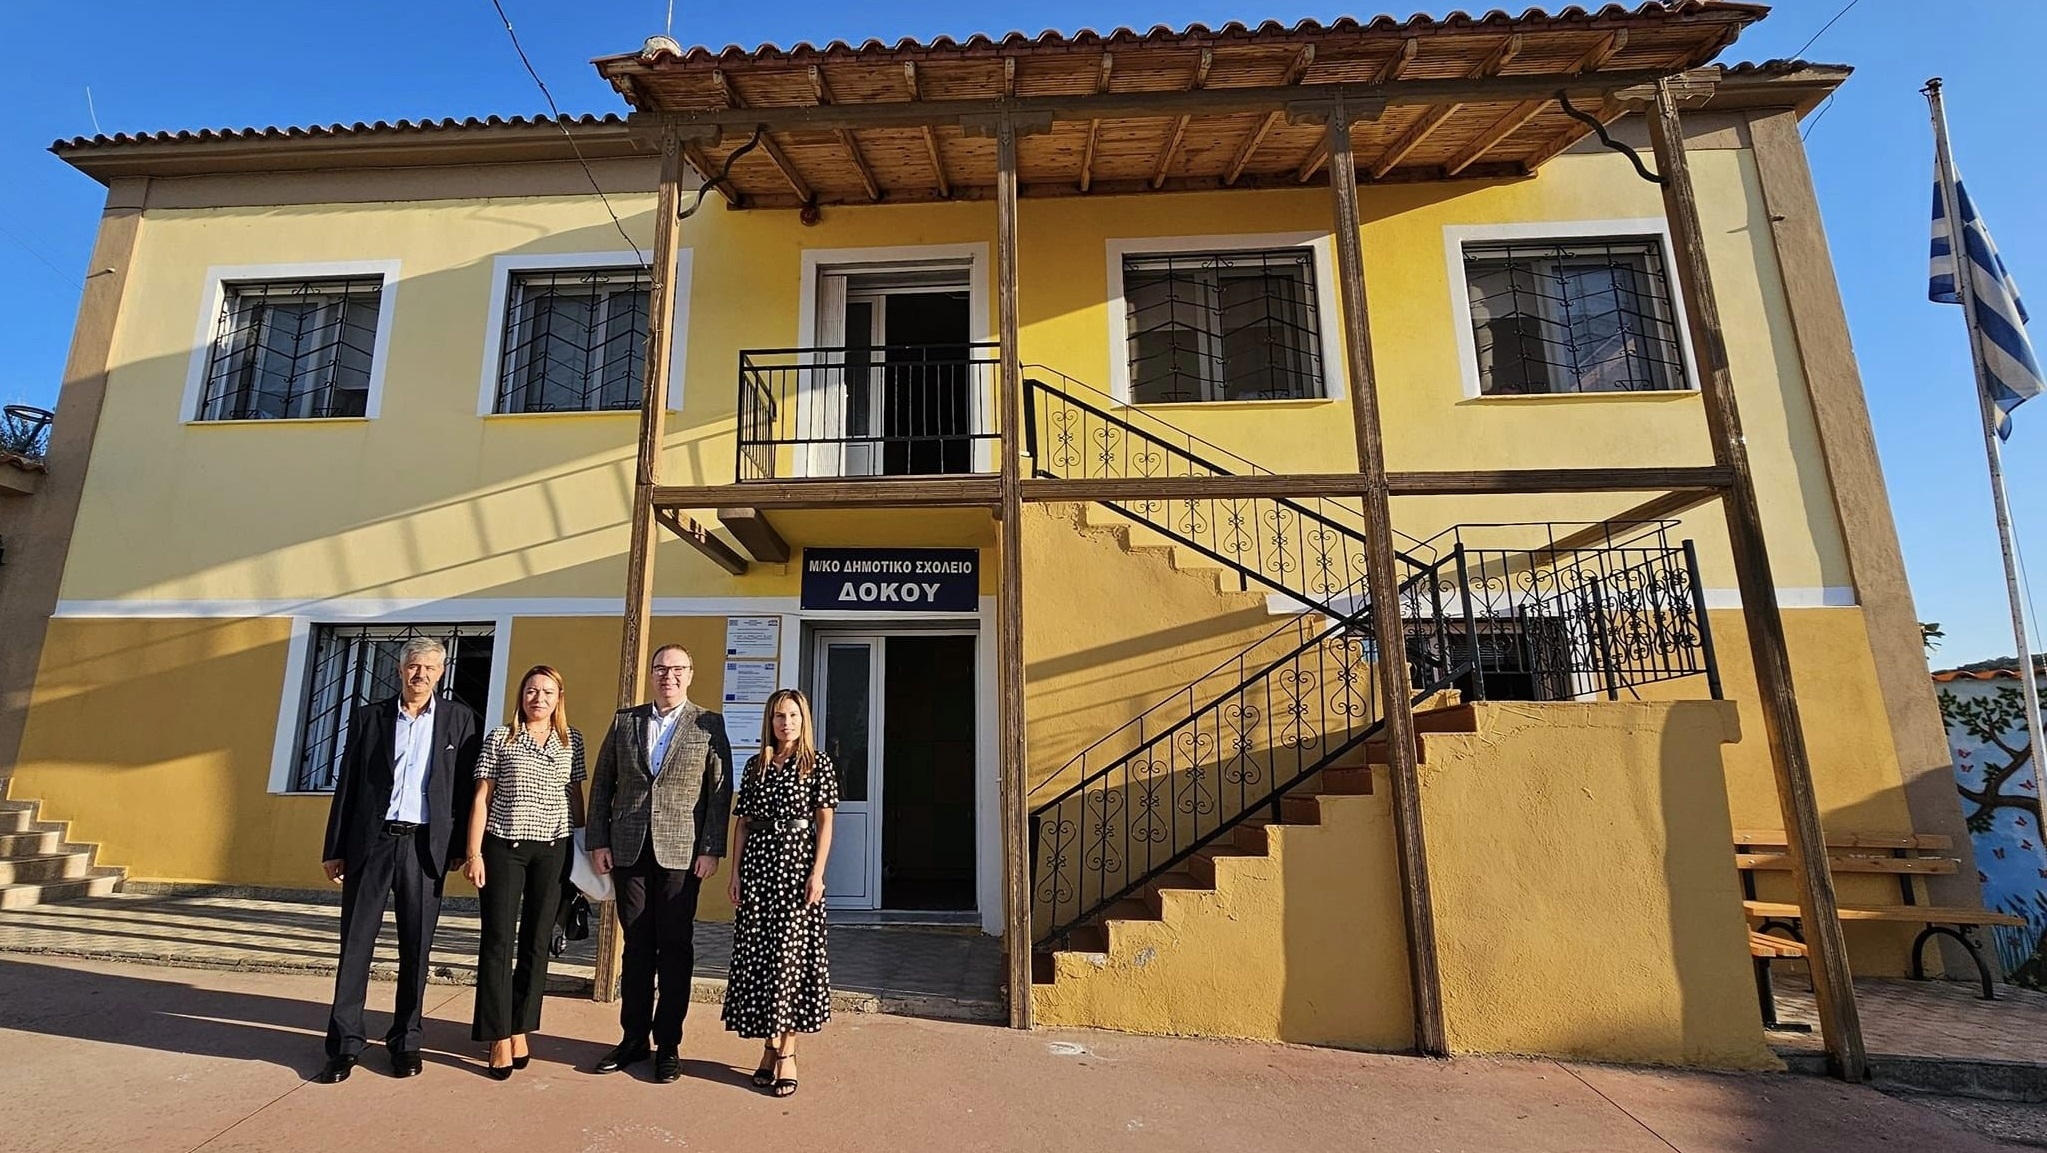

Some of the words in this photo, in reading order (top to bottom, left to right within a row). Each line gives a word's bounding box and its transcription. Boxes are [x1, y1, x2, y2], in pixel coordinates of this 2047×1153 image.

[809, 560, 840, 573] Μ/ΚΟ
[843, 560, 912, 573] ΔΗΜΟΤΙΚΟ
[915, 561, 972, 574] ΣΧΟΛΕΙΟ
[838, 582, 941, 602] ΔΟΚΟΥ
